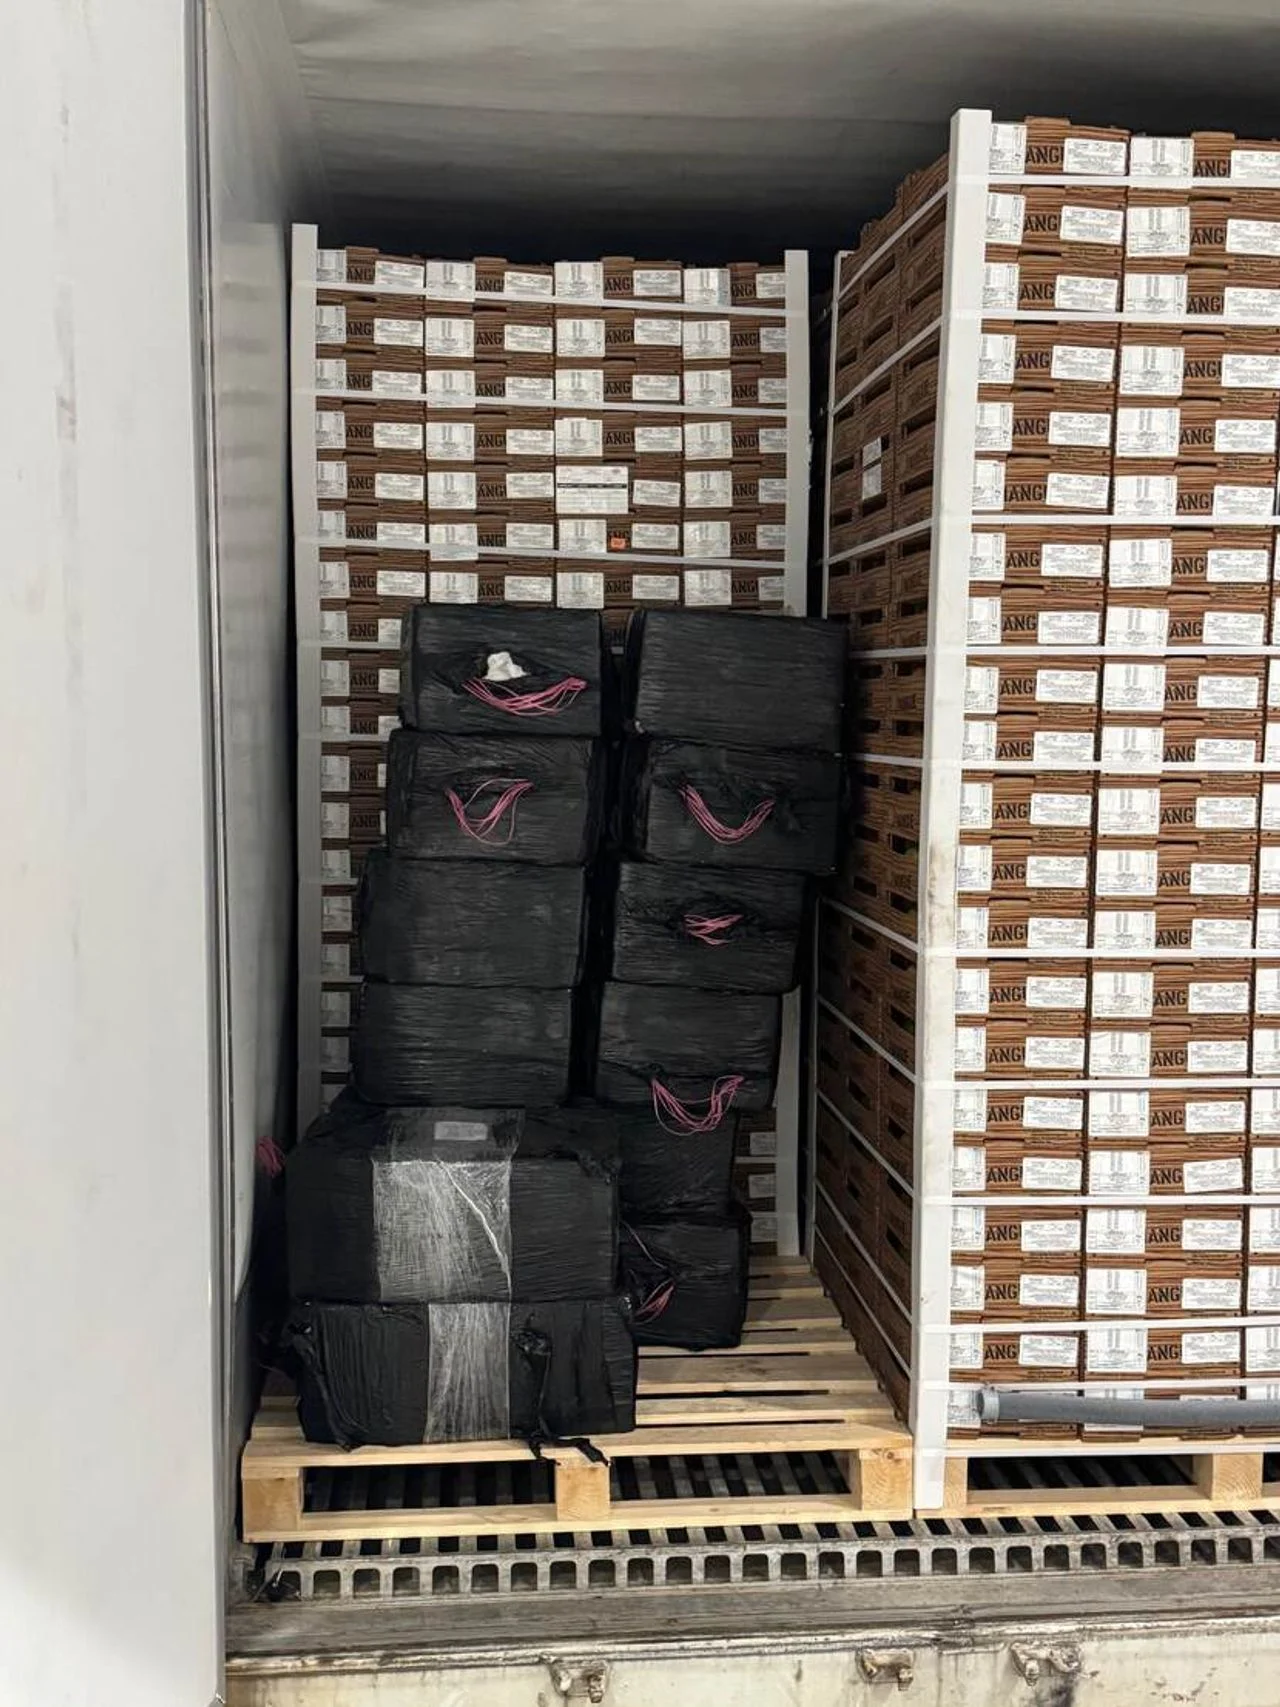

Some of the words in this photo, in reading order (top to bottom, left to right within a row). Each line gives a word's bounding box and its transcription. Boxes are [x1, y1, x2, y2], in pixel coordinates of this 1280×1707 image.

[1026, 147, 1064, 163] ANG
[1194, 159, 1230, 176] ANG
[1024, 216, 1057, 231] ANG
[1191, 227, 1225, 244] ANG
[605, 278, 633, 291] ANG
[731, 283, 756, 297] ANG
[1021, 285, 1054, 300] ANG
[1187, 296, 1224, 314] ANG
[1016, 353, 1049, 368] ANG
[1185, 361, 1221, 377] ANG
[476, 384, 504, 396] ANG
[1013, 420, 1048, 435] ANG
[477, 434, 505, 447] ANG
[606, 432, 634, 444] ANG
[733, 434, 759, 447] ANG
[1180, 428, 1213, 444] ANG
[1005, 485, 1046, 500] ANG
[1177, 494, 1213, 510] ANG
[347, 526, 376, 538] ANG
[1006, 552, 1039, 567] ANG
[1172, 558, 1207, 574] ANG
[731, 580, 758, 594] ANG
[1003, 616, 1036, 631] ANG
[1170, 622, 1202, 636] ANG
[1001, 679, 1035, 695] ANG
[1165, 685, 1196, 700] ANG
[998, 741, 1033, 757] ANG
[1164, 747, 1196, 762] ANG
[994, 804, 1030, 819] ANG
[1161, 808, 1196, 823] ANG
[992, 865, 1026, 880] ANG
[1159, 872, 1190, 887] ANG
[991, 926, 1027, 941] ANG
[1156, 930, 1191, 945] ANG
[990, 988, 1026, 1002] ANG
[1154, 991, 1187, 1006] ANG
[989, 1048, 1025, 1063] ANG
[1152, 1052, 1188, 1066] ANG
[988, 1106, 1023, 1121] ANG
[1151, 1110, 1183, 1126] ANG
[987, 1167, 1023, 1182] ANG
[1149, 1169, 1182, 1184] ANG
[986, 1225, 1020, 1241] ANG
[1149, 1228, 1180, 1242] ANG
[985, 1284, 1020, 1299] ANG
[1148, 1287, 1181, 1301] ANG
[984, 1344, 1017, 1359] ANG
[1148, 1346, 1180, 1360] ANG
